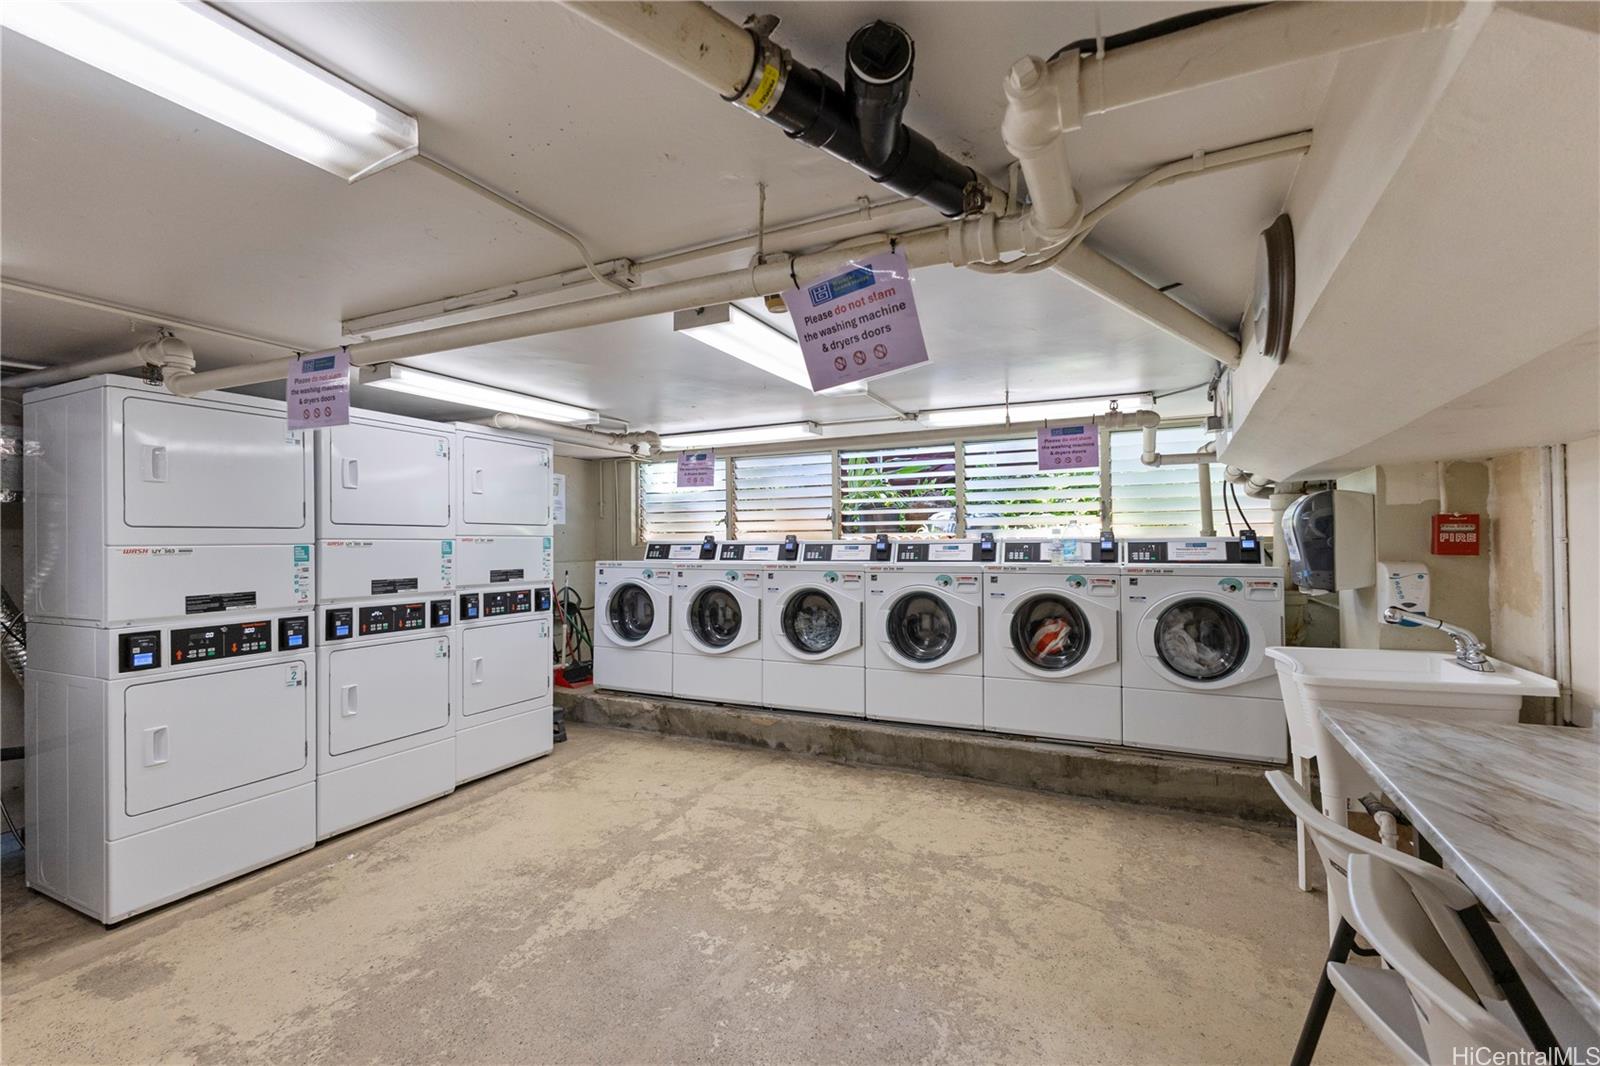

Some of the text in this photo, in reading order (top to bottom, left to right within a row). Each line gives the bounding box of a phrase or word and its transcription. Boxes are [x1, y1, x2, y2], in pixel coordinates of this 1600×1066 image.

[804, 287, 897, 326] Please do not slam
[804, 302, 906, 342] the washing machine
[822, 324, 892, 353] & dryers doors
[294, 377, 311, 385] Please
[300, 386, 321, 394] washing
[303, 397, 320, 405] dryers
[1439, 532, 1477, 542] FIRE
[291, 671, 297, 680] 2
